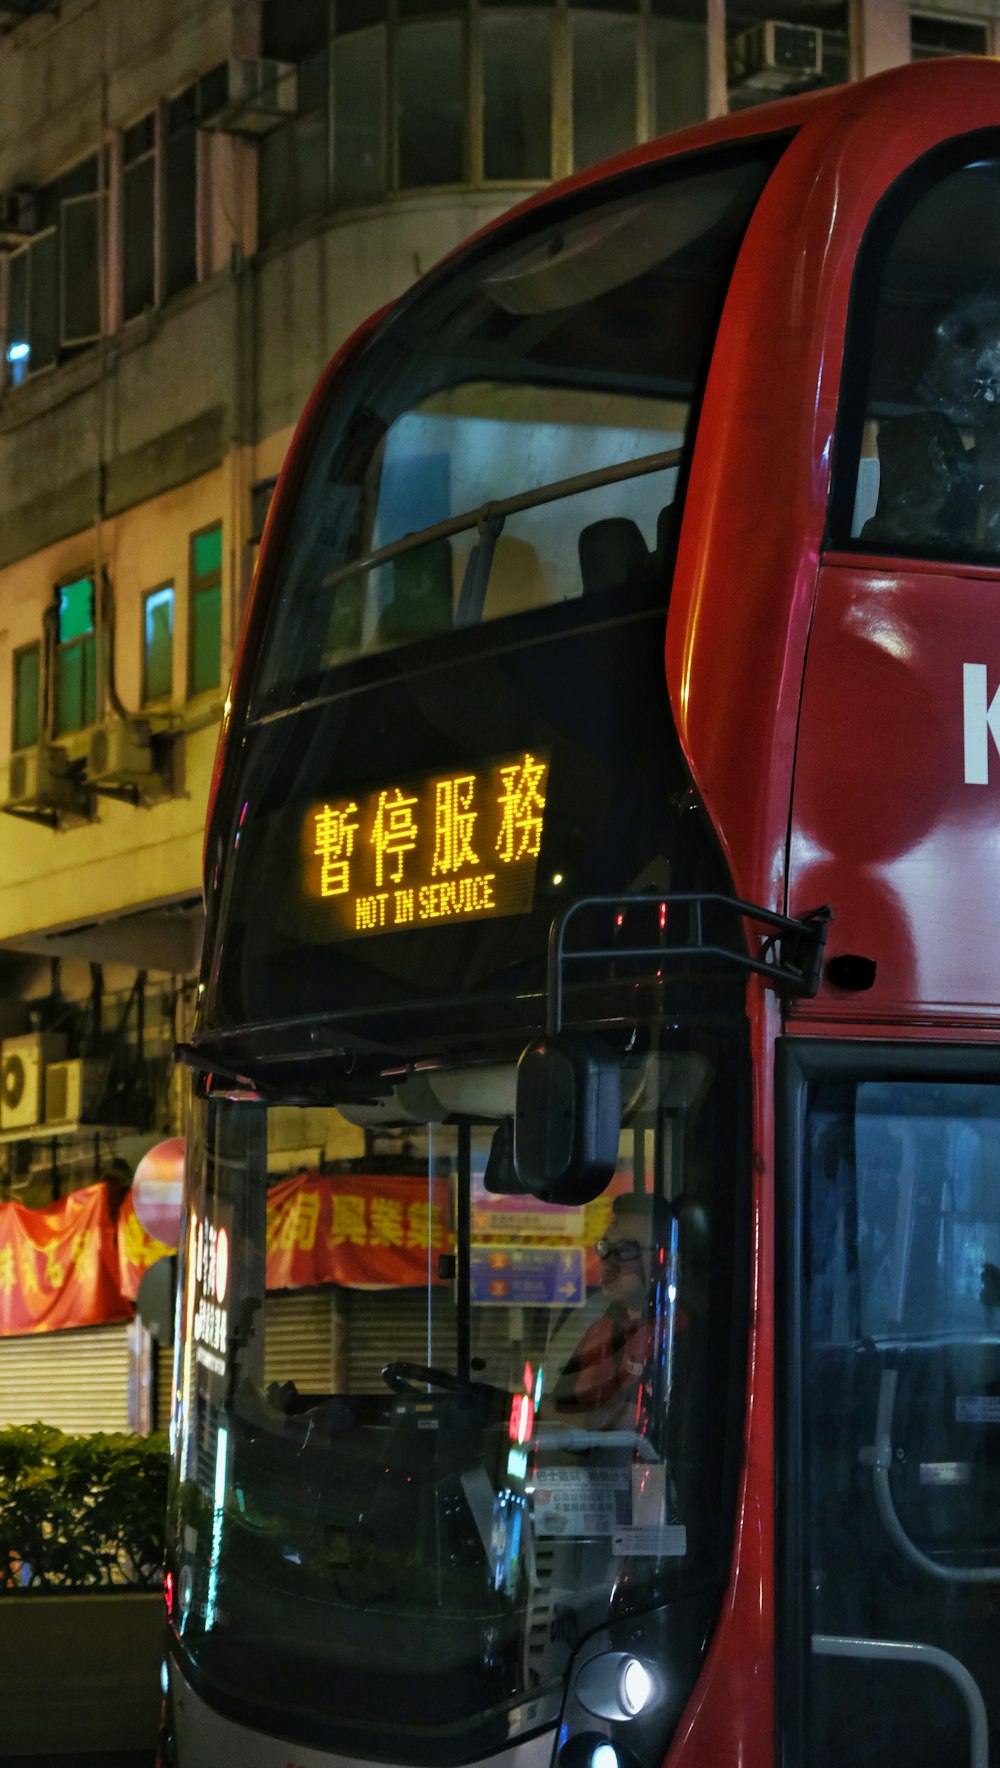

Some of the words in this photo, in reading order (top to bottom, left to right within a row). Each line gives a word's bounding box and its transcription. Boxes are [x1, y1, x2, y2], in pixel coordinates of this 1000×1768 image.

[313, 753, 546, 897] 暫停服務
[355, 894, 390, 930] NOT
[394, 889, 414, 924] IN
[419, 873, 496, 919] SERVICE
